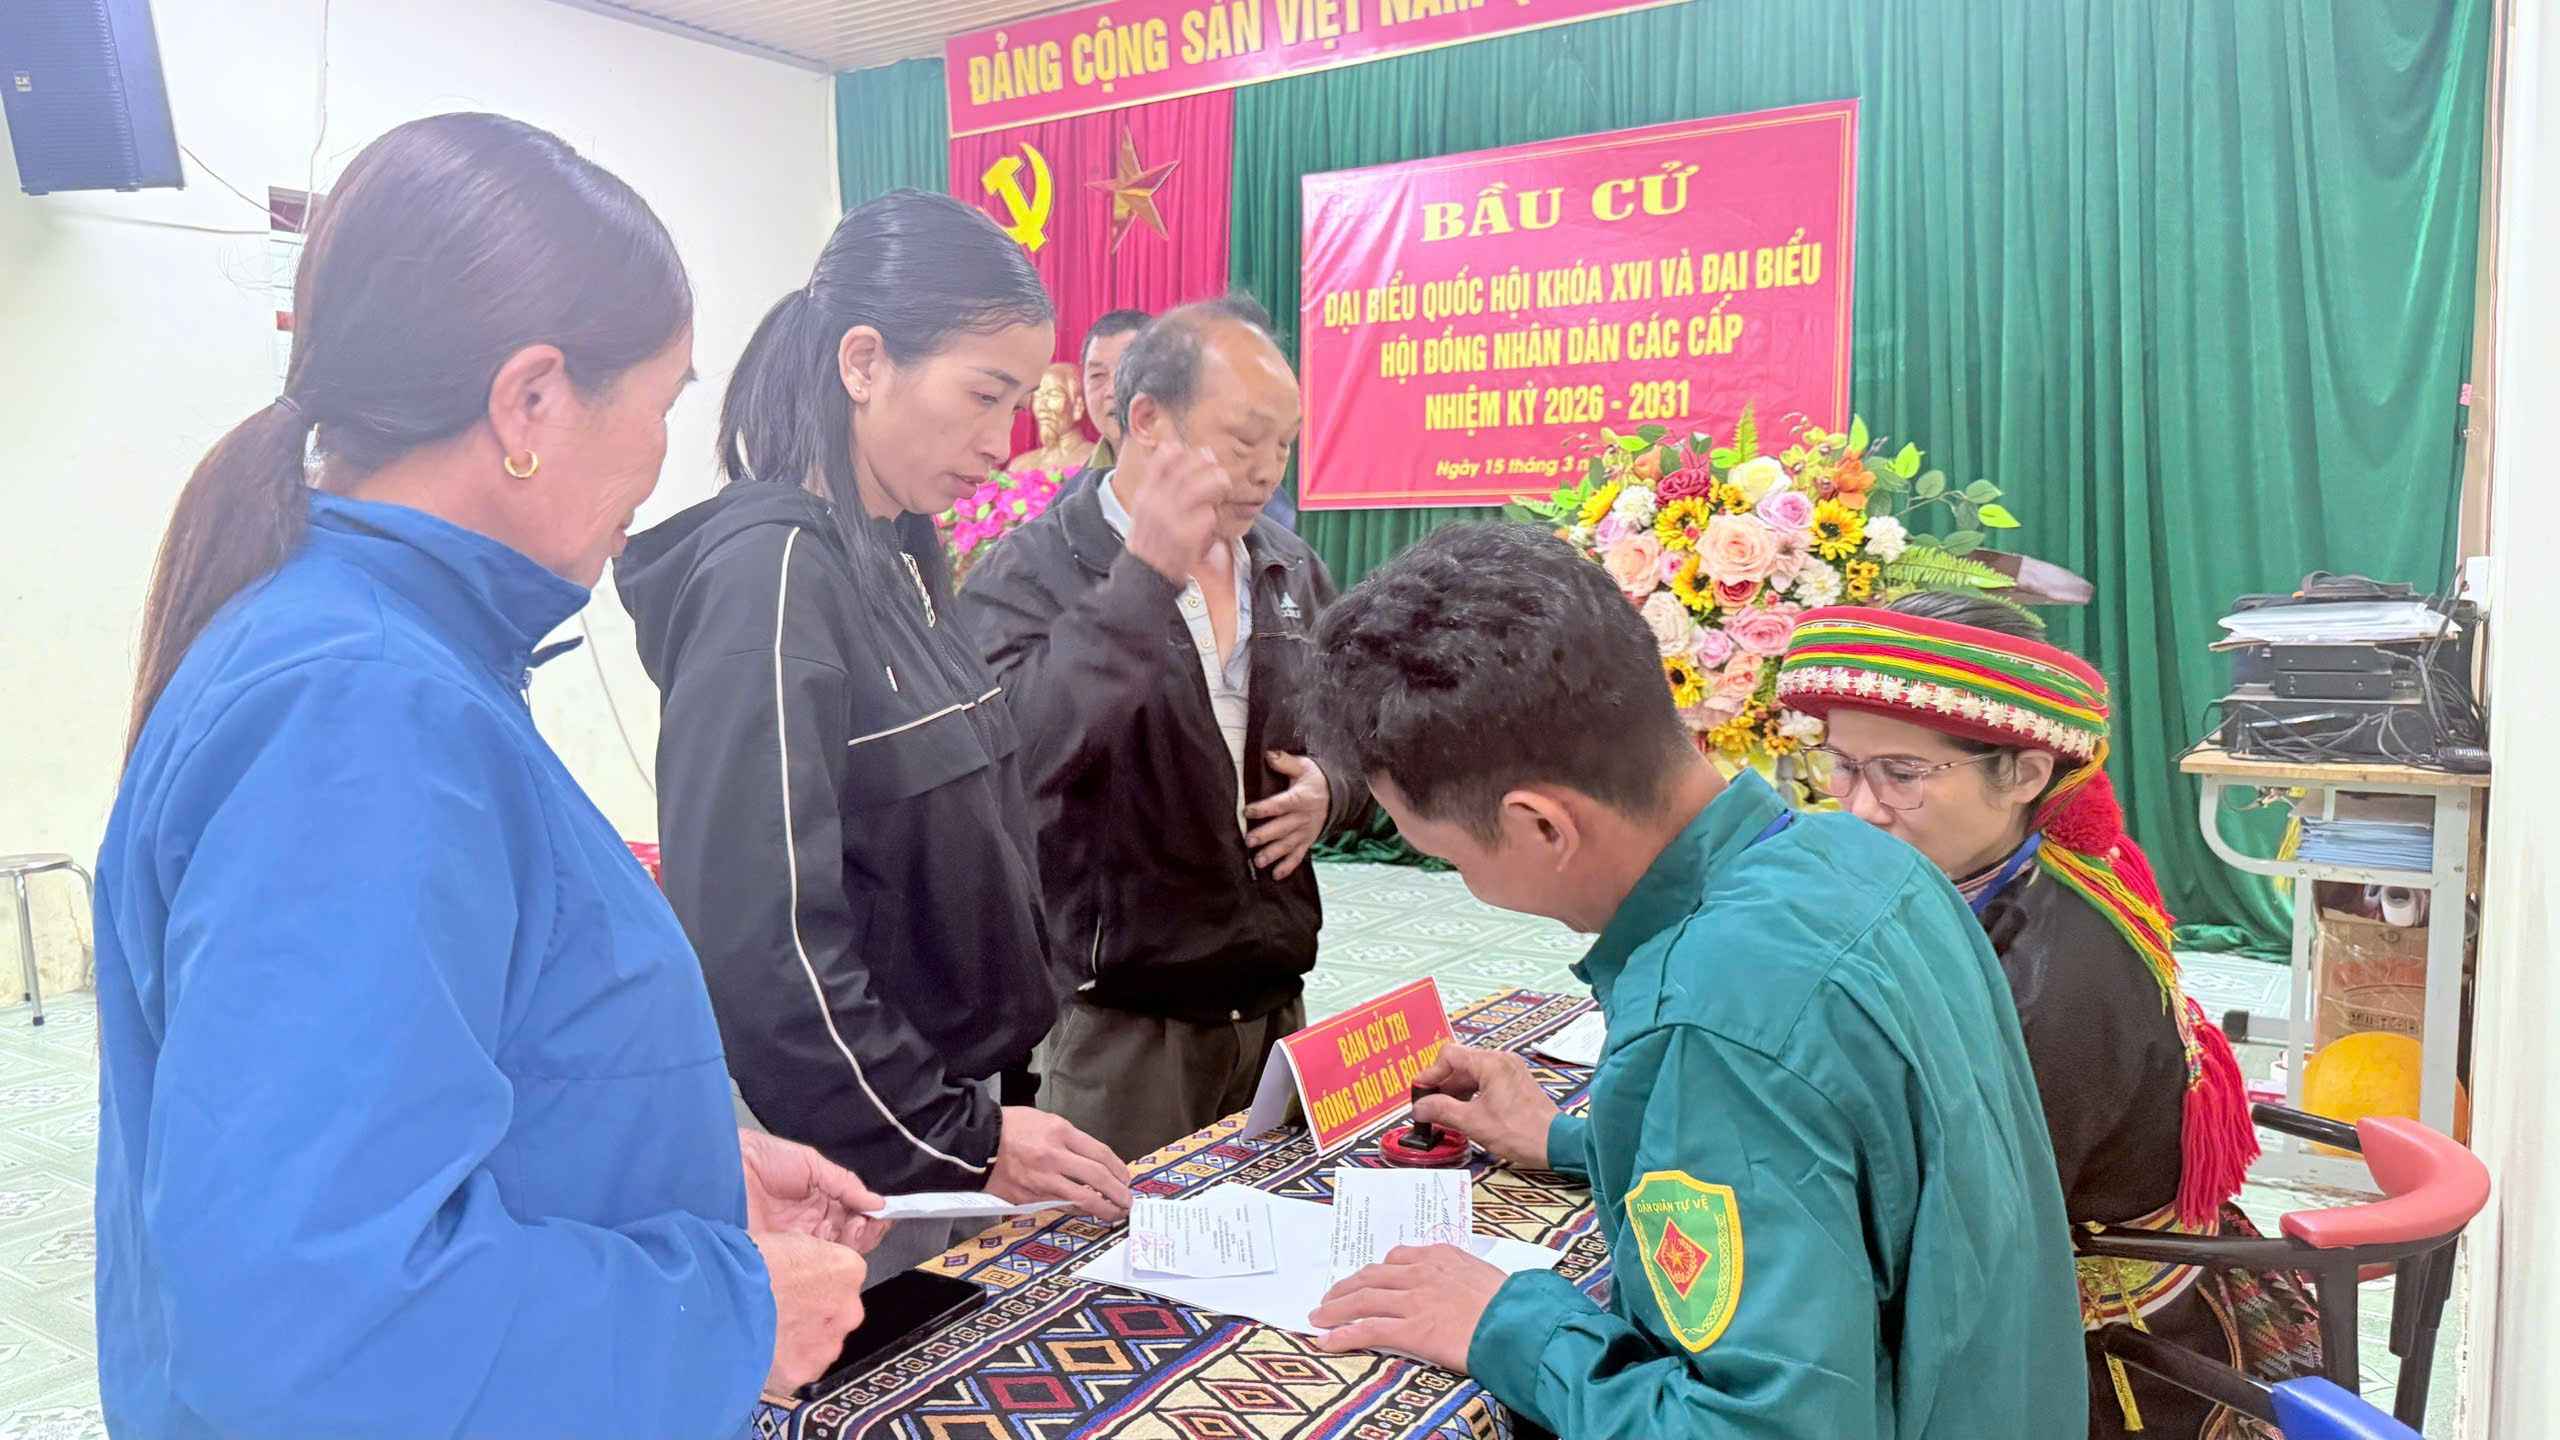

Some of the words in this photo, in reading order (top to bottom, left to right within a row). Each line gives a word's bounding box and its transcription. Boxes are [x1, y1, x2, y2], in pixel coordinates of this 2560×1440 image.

[969, 31, 1063, 105] ĐẢNG
[1072, 16, 1169, 92] CỘNG
[1181, 0, 1262, 64] SẢN
[1421, 181, 1565, 242] BẦU
[1592, 160, 1699, 221] CỬ
[1325, 290, 1361, 334] ĐẠI
[1367, 271, 1416, 324] BIỂU
[1422, 266, 1483, 322] QUỐC
[1490, 265, 1532, 319] HỘI
[1537, 258, 1603, 306] KHÓA
[1611, 261, 1653, 301] XVI
[1661, 248, 1694, 296] VÀ
[1701, 250, 1748, 300] ĐẠI
[1756, 227, 1822, 289] BIỂU
[1381, 333, 1417, 384] HỘI
[1493, 322, 1561, 369] NHÂN
[1567, 317, 1620, 365] DÂN
[1627, 312, 1679, 359] CÁC
[1688, 300, 1744, 355] CẤP
[1425, 384, 1500, 435] NHIỆM
[1507, 381, 1539, 426] KỲ
[1544, 385, 1604, 425] 2026
[1628, 380, 1690, 421] 2031
[1436, 459, 1480, 479] Ngày
[1486, 459, 1505, 474] 15
[1508, 456, 1558, 477] tháng
[1562, 456, 1574, 472] 3
[1338, 1027, 1369, 1067] BÀN
[1367, 1011, 1388, 1053] CỬ
[1386, 1010, 1410, 1044] TRI
[1313, 1088, 1357, 1133] ĐÓNG
[1352, 1065, 1382, 1112] DẤU
[1379, 1058, 1403, 1098] ĐÃ
[1399, 1045, 1418, 1086] BỎ
[1417, 1030, 1449, 1070] PHI
[1652, 1199, 1674, 1213] QUÂN
[1674, 1198, 1690, 1213] TỰ
[1692, 1194, 1709, 1212] VỆ
